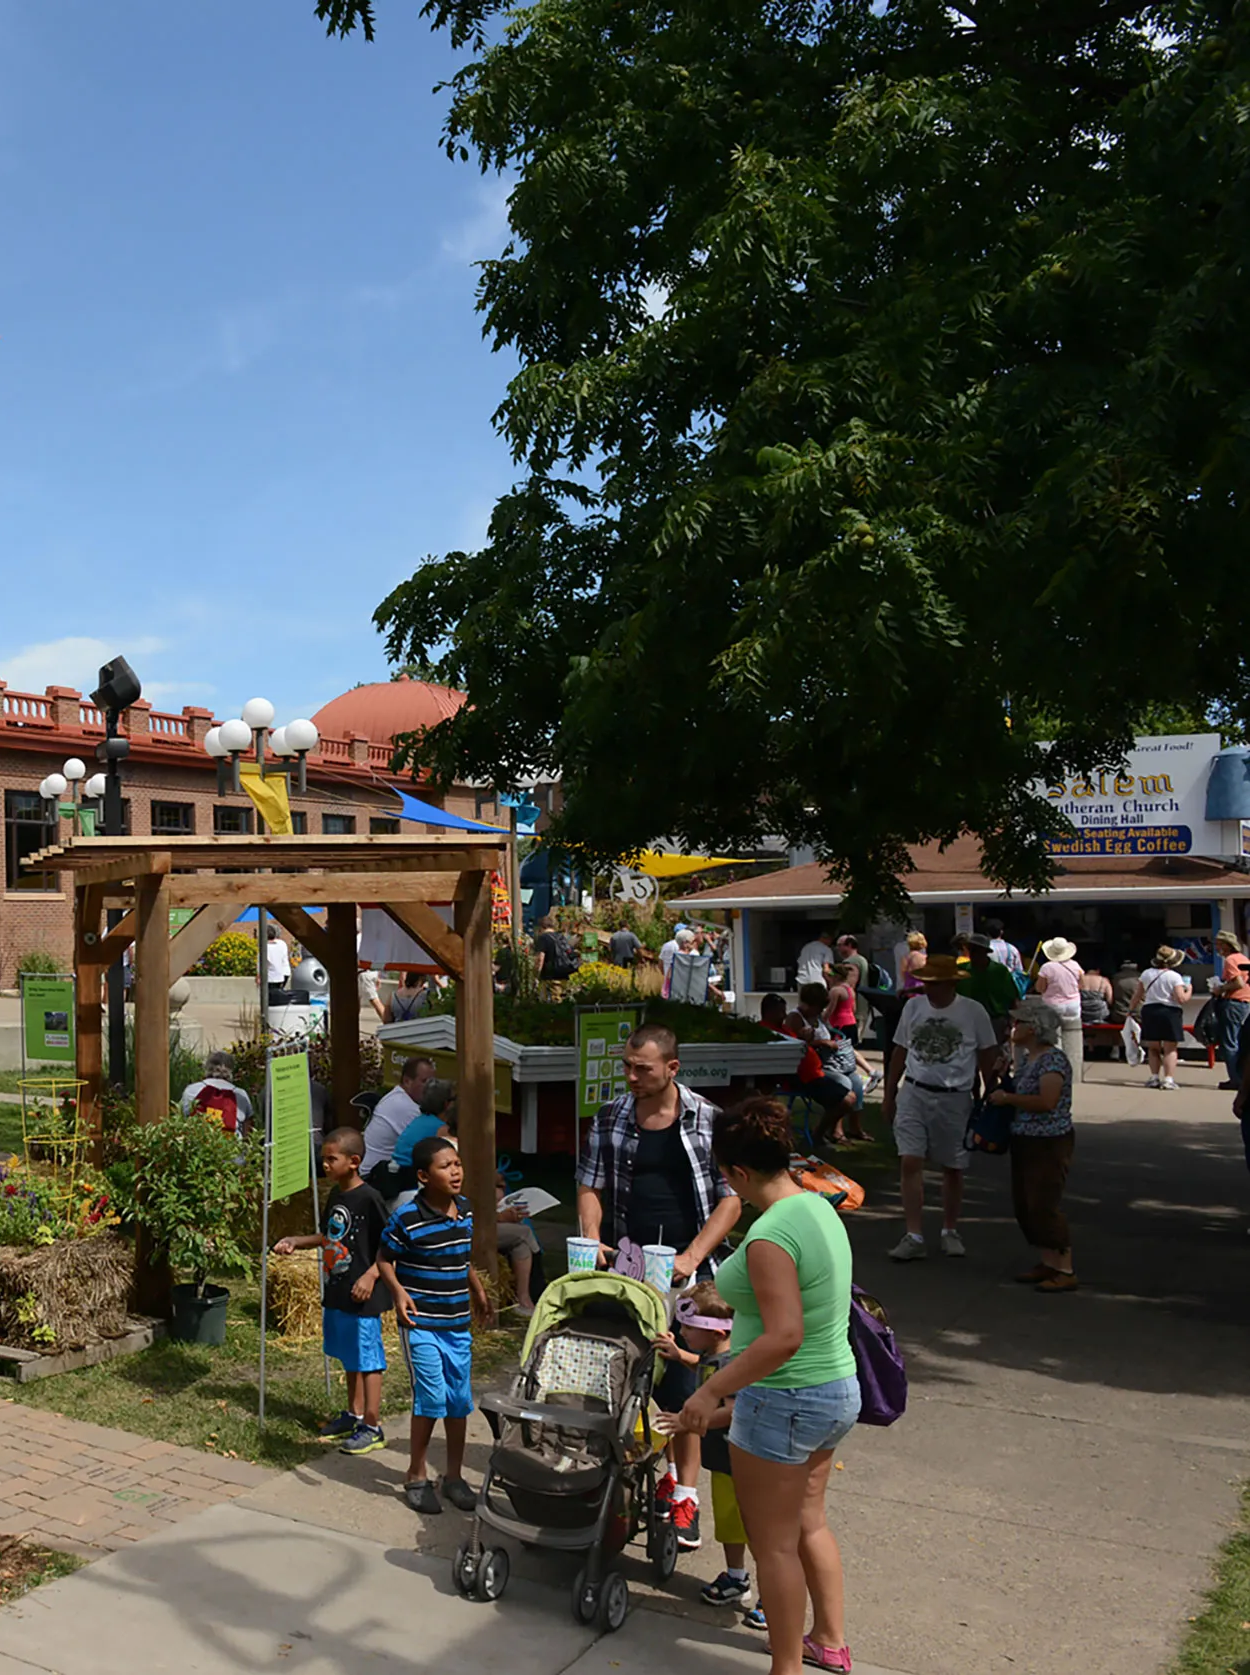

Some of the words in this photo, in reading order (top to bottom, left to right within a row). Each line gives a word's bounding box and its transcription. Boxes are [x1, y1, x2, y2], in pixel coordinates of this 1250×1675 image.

[1164, 742, 1194, 751] Food!
[1123, 798, 1179, 813] Church
[1081, 814, 1118, 826] Dining
[1120, 814, 1144, 825] Hall
[1083, 828, 1126, 840] Seating
[1127, 827, 1179, 838] Available
[1043, 840, 1101, 853] Swedish
[1105, 839, 1132, 855] Egg
[1137, 838, 1187, 852] Coffee
